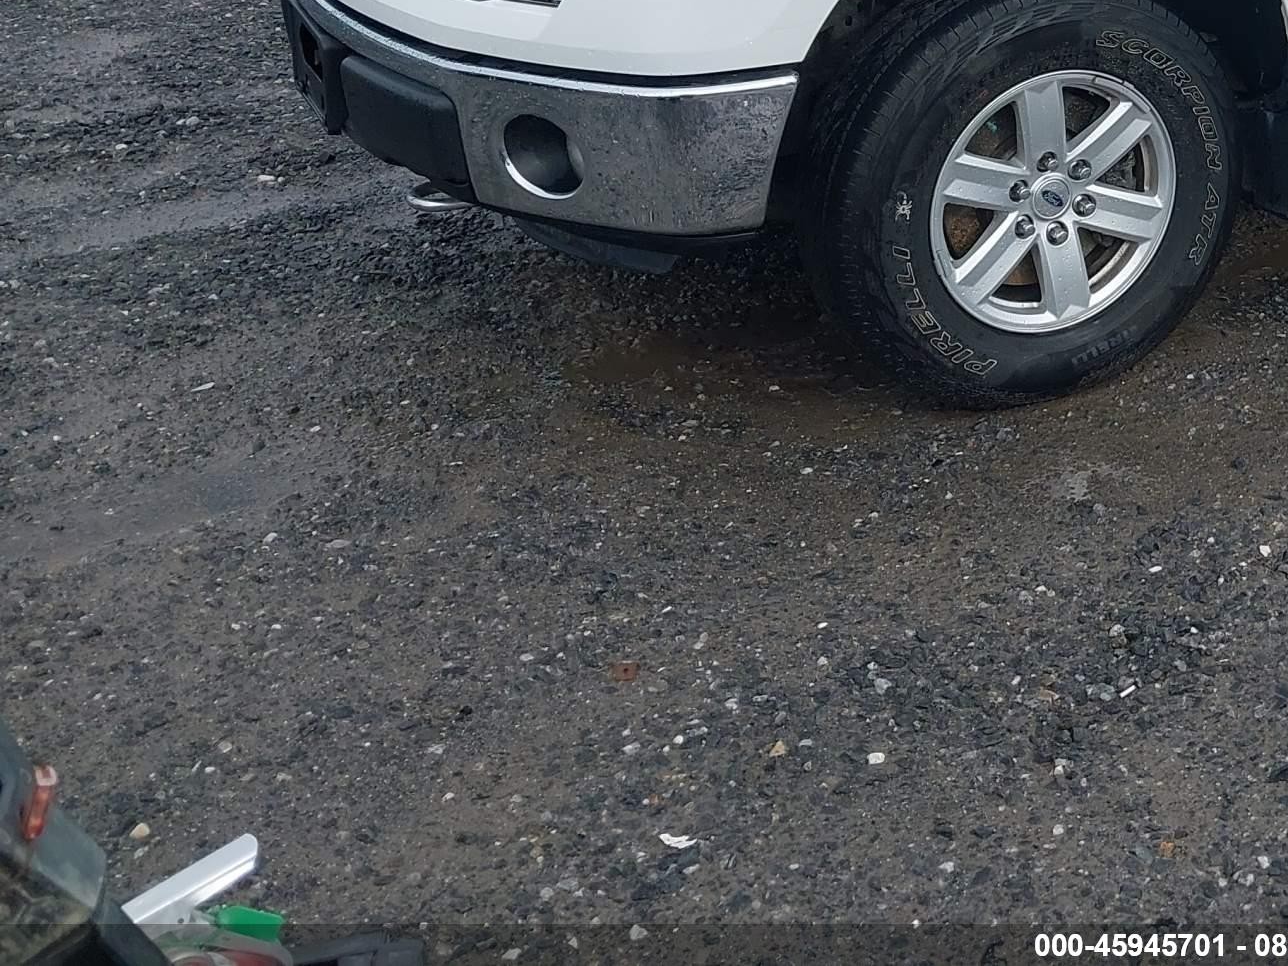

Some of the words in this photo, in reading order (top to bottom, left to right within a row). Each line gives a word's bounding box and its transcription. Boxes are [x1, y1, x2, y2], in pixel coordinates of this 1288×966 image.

[1096, 30, 1222, 171] SCORPION
[1189, 183, 1220, 266] ATR
[892, 245, 998, 375] PIRELLI
